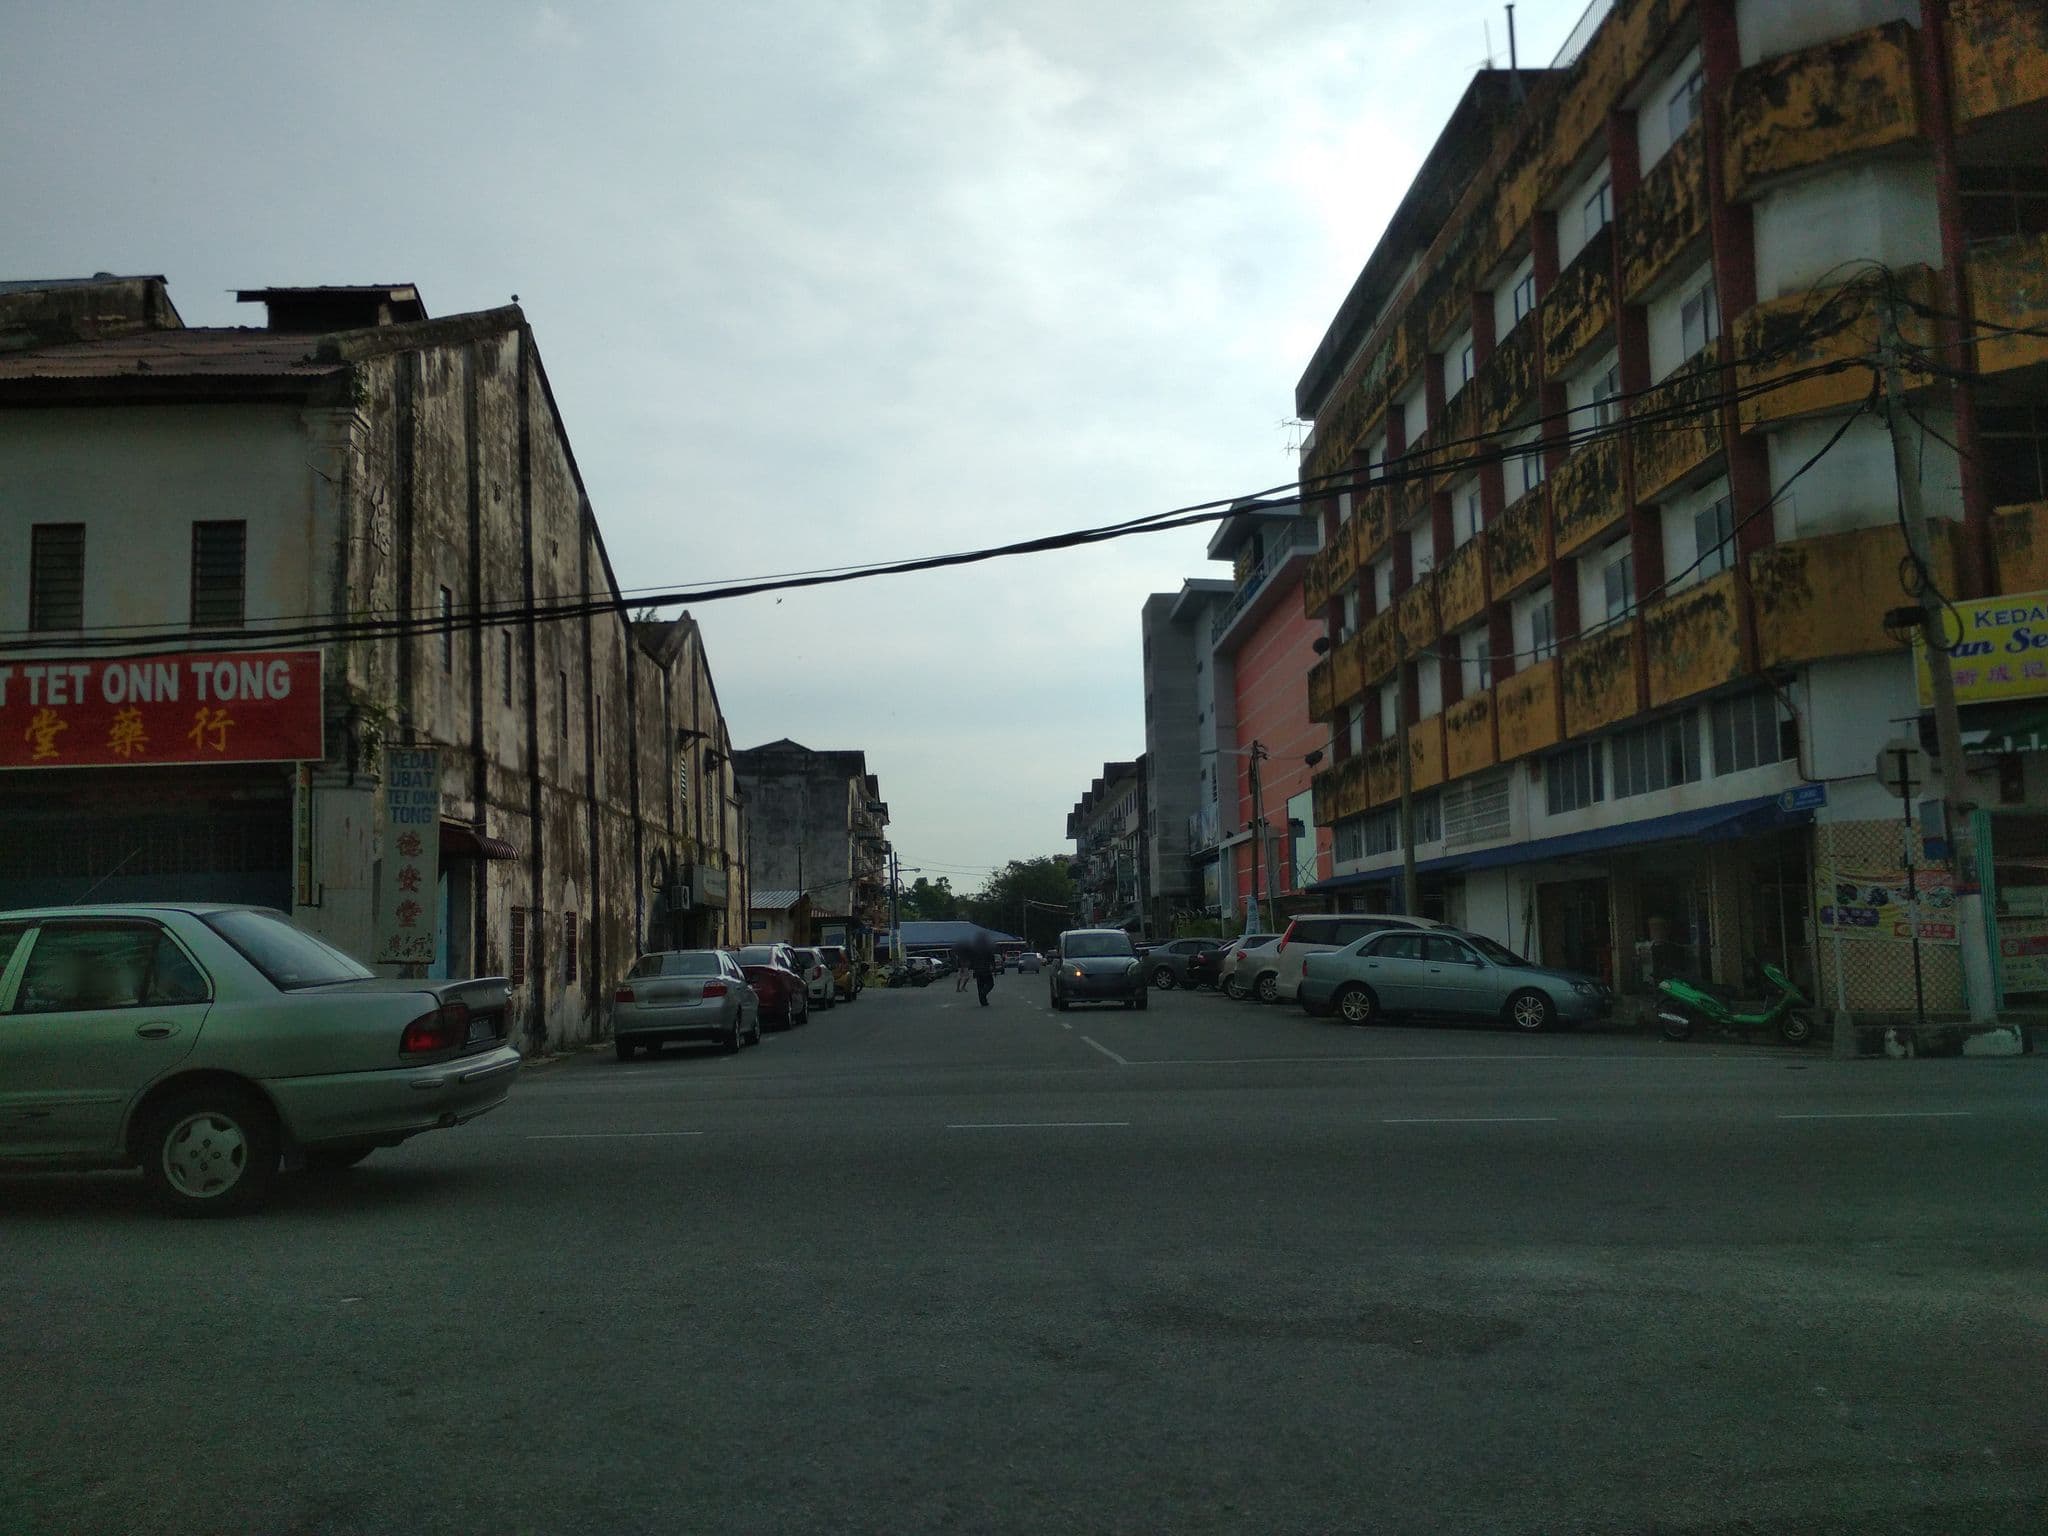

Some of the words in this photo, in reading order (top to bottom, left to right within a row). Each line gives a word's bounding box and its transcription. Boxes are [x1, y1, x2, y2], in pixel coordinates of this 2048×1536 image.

[1974, 607, 2048, 629] KEDA
[23, 665, 92, 705] TET
[102, 663, 180, 704] ONN
[191, 660, 292, 701] TONG
[390, 770, 433, 787] UBAT
[388, 789, 409, 804] TET
[413, 789, 438, 804] ONN
[390, 806, 433, 824] TONG
